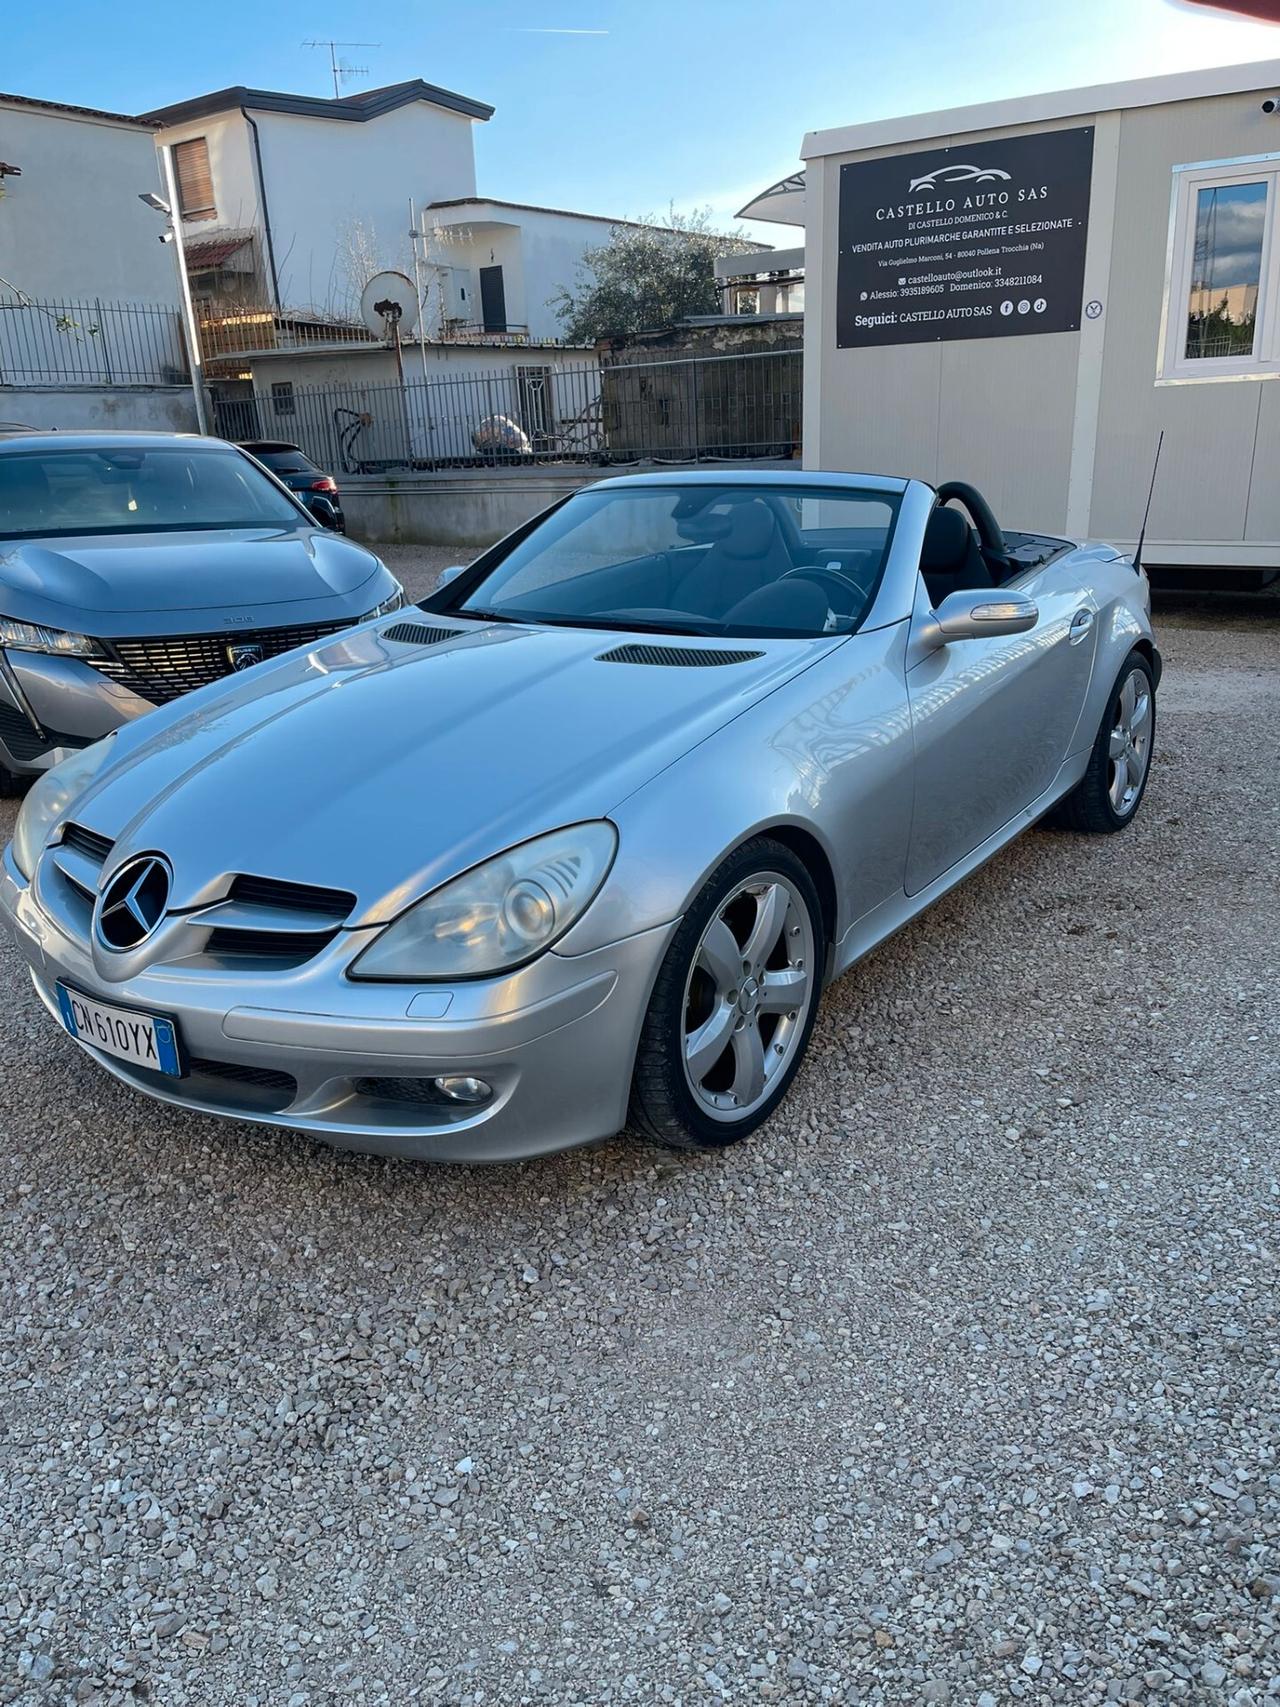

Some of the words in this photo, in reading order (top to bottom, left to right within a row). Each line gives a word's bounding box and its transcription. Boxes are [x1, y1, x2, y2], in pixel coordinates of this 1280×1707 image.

[876, 199, 955, 221] CASTELLO
[963, 191, 1009, 209] AUTO
[1018, 186, 1048, 202] SAS
[908, 222, 916, 230] DI
[916, 217, 953, 230] CASTELLO
[954, 212, 994, 226] DOMENICO
[995, 210, 1001, 219] &
[852, 242, 883, 253] VENDITA
[884, 239, 904, 249] AUTO
[904, 232, 961, 247] PLURIMARCHE
[962, 226, 1008, 240] GARANTITE
[1008, 225, 1014, 235] E
[1014, 218, 1073, 234] SELEZIONATE
[888, 257, 917, 267] Guglielmo
[945, 252, 952, 260] 54
[957, 249, 976, 258] 80040
[977, 247, 1000, 257] Pollena
[1001, 243, 1029, 254] Trocchia
[1030, 241, 1045, 251] (Na)
[870, 290, 899, 300] Alessio:
[900, 284, 944, 297] 3935189605
[950, 280, 992, 292] Domenico:
[994, 274, 1042, 288] 3348211084
[908, 267, 1002, 284] castelloauto@outlook.it
[855, 312, 898, 328] Seguici:
[900, 309, 945, 323] CASTELLO
[946, 307, 972, 319] AUTO
[973, 306, 993, 317] SAS
[72, 1000, 95, 1036] CN
[94, 1012, 158, 1060] 610YX
